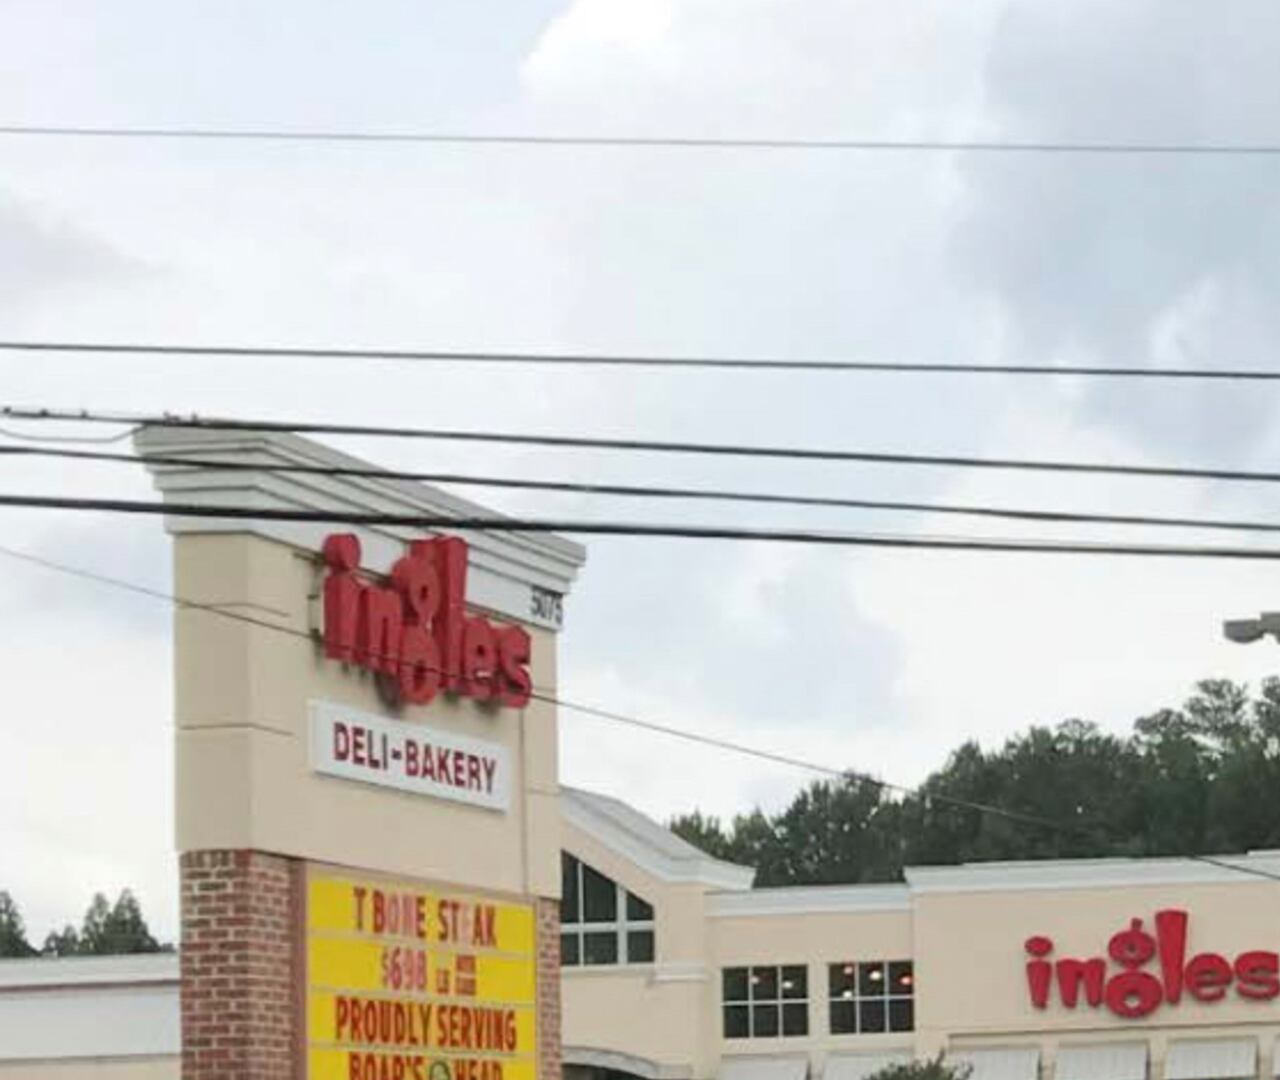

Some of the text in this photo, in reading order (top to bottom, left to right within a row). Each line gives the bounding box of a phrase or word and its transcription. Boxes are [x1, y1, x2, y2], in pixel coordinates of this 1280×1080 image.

[322, 533, 533, 709] ingles
[333, 721, 496, 793] DELI-BAKERY
[354, 887, 366, 931] T
[373, 889, 425, 938] BONE
[1025, 910, 1280, 1018] ingles
[335, 996, 516, 1051] PROUDLY SERVING
